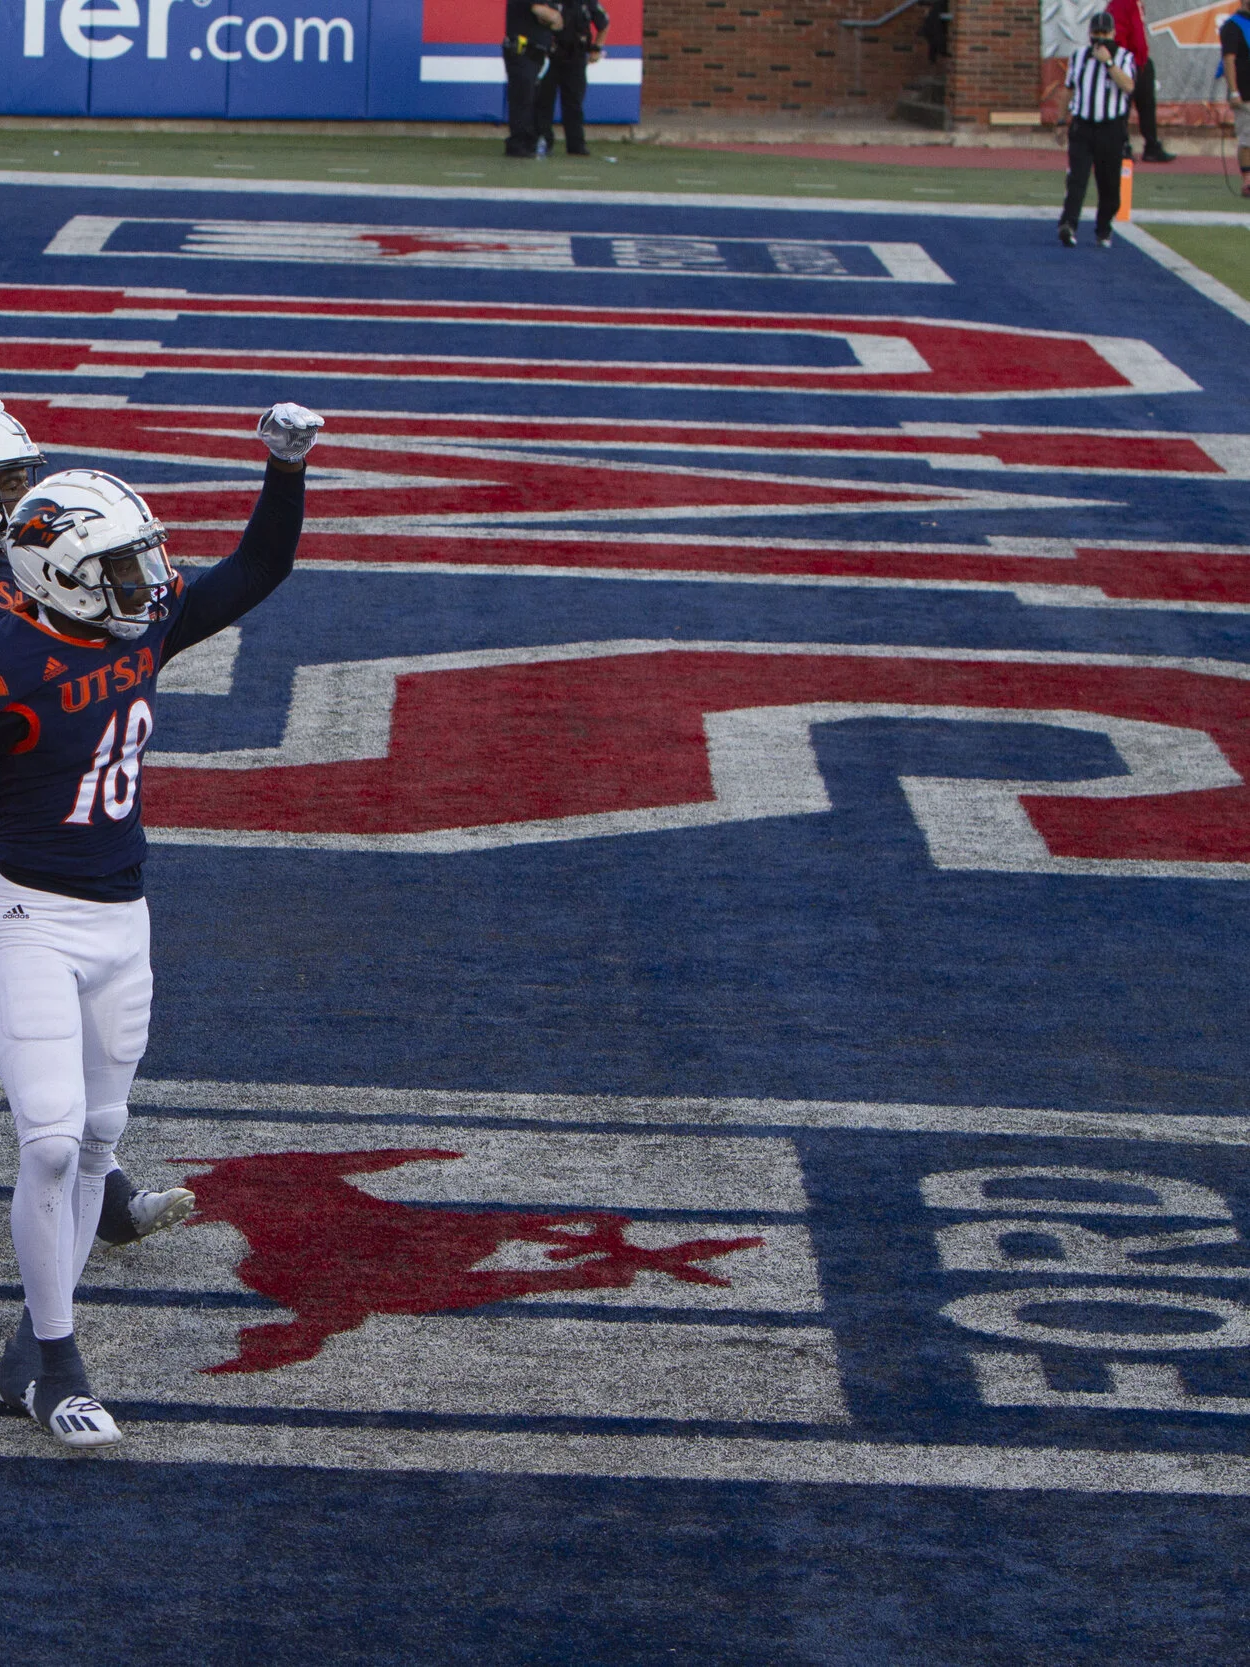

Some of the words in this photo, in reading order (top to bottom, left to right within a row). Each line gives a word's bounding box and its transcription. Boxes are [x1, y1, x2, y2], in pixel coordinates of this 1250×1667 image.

[58, 647, 154, 713] UTSA
[59, 697, 153, 826] 18
[920, 1164, 1250, 1418] FORD
